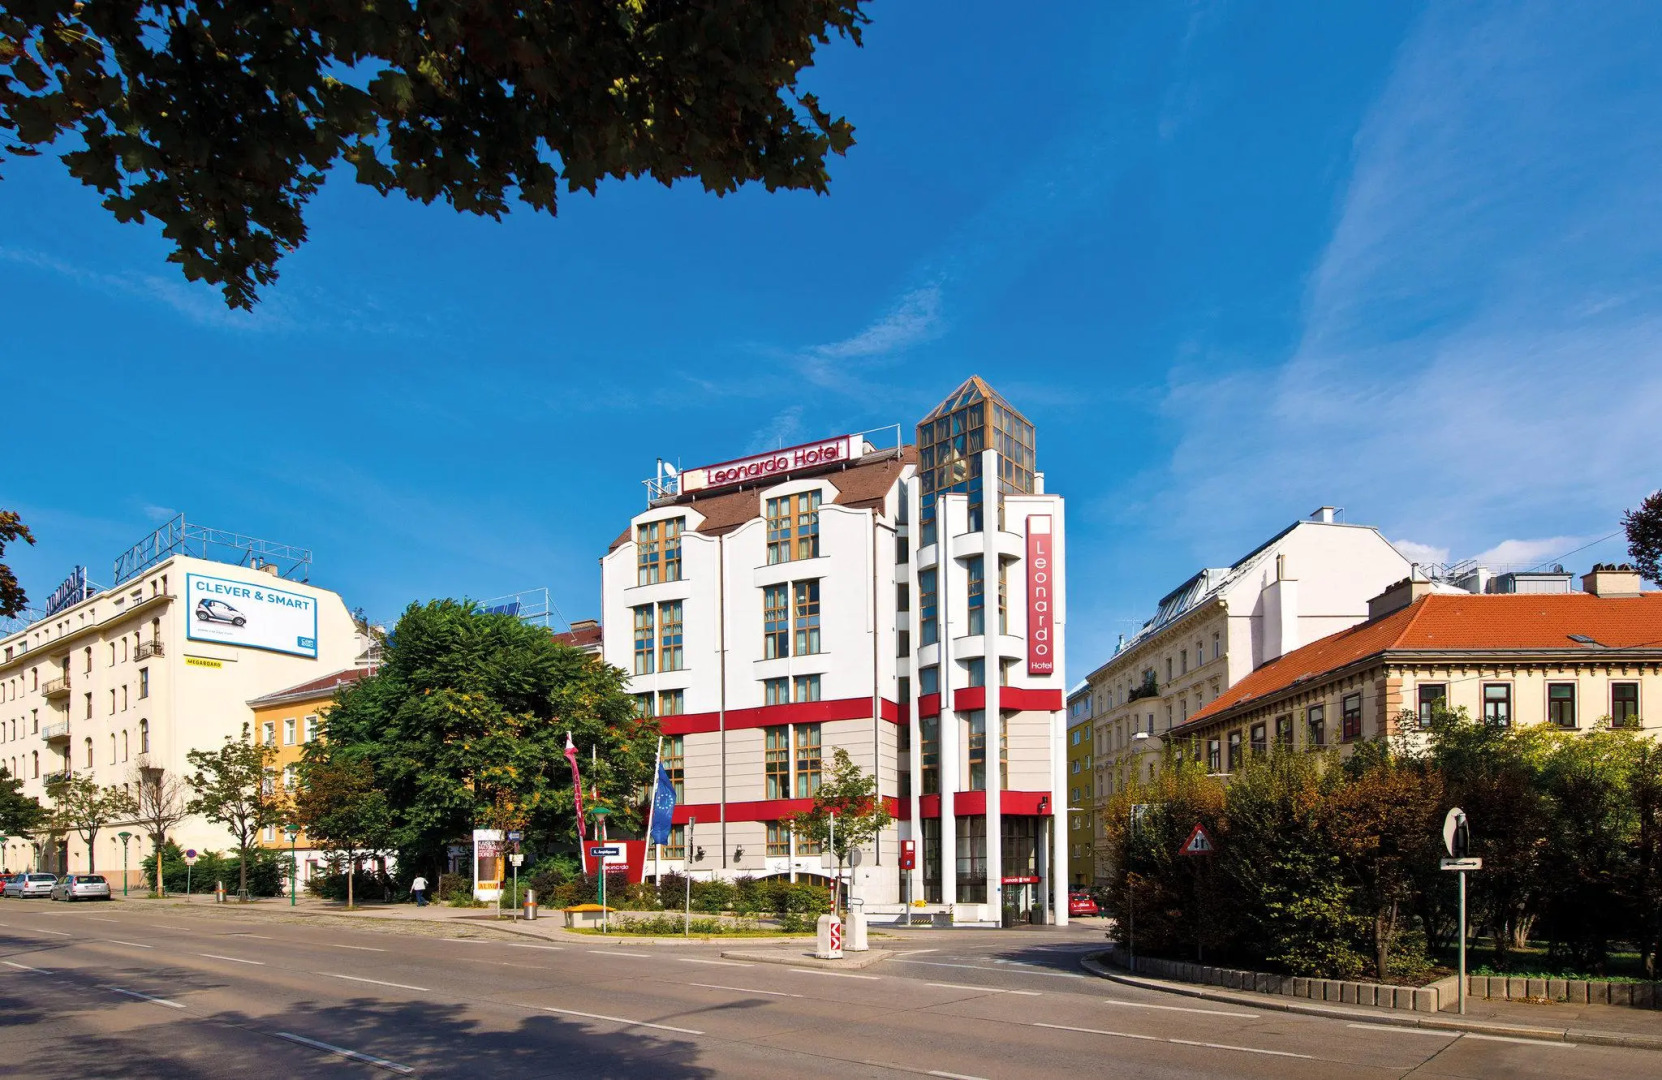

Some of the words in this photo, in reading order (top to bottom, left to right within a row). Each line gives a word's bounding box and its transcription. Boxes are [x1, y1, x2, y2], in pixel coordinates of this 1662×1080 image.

[707, 456, 788, 485] Leonardo
[794, 441, 840, 465] Hotel
[196, 581, 251, 599] CLEVER
[254, 591, 264, 601] &
[267, 594, 310, 610] SMART
[1035, 541, 1048, 655] Leonardo
[1032, 661, 1053, 669] Hotel
